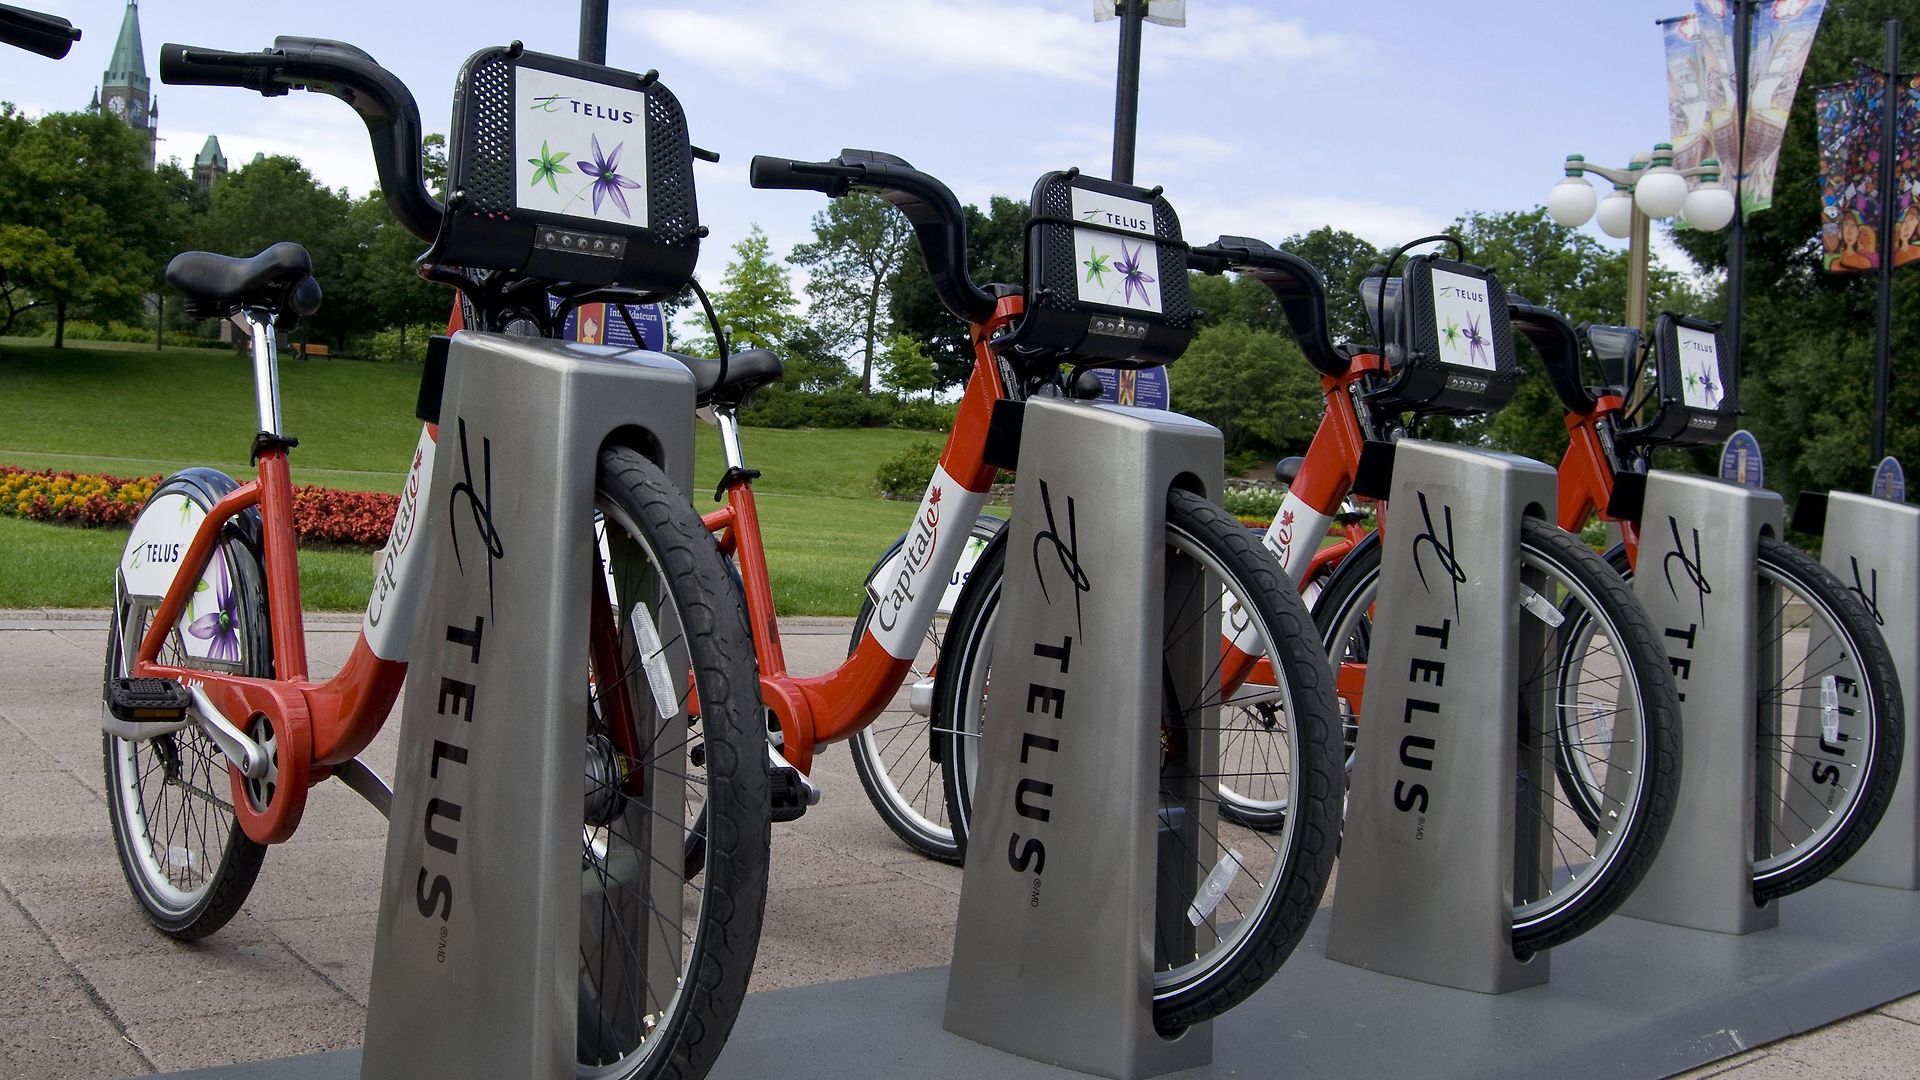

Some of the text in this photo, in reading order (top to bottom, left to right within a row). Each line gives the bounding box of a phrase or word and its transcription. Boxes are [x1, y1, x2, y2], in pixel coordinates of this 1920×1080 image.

[570, 100, 633, 125] TELUS
[1106, 212, 1147, 231] TELUS
[1455, 288, 1484, 303] TELUS
[1693, 342, 1713, 353] TELUS
[147, 543, 180, 563] TELUS
[369, 470, 420, 628] Capitale
[879, 505, 940, 632] Capitale
[1394, 619, 1451, 814] TELUS
[416, 616, 484, 922] TELUS
[1008, 635, 1072, 875] TELUS
